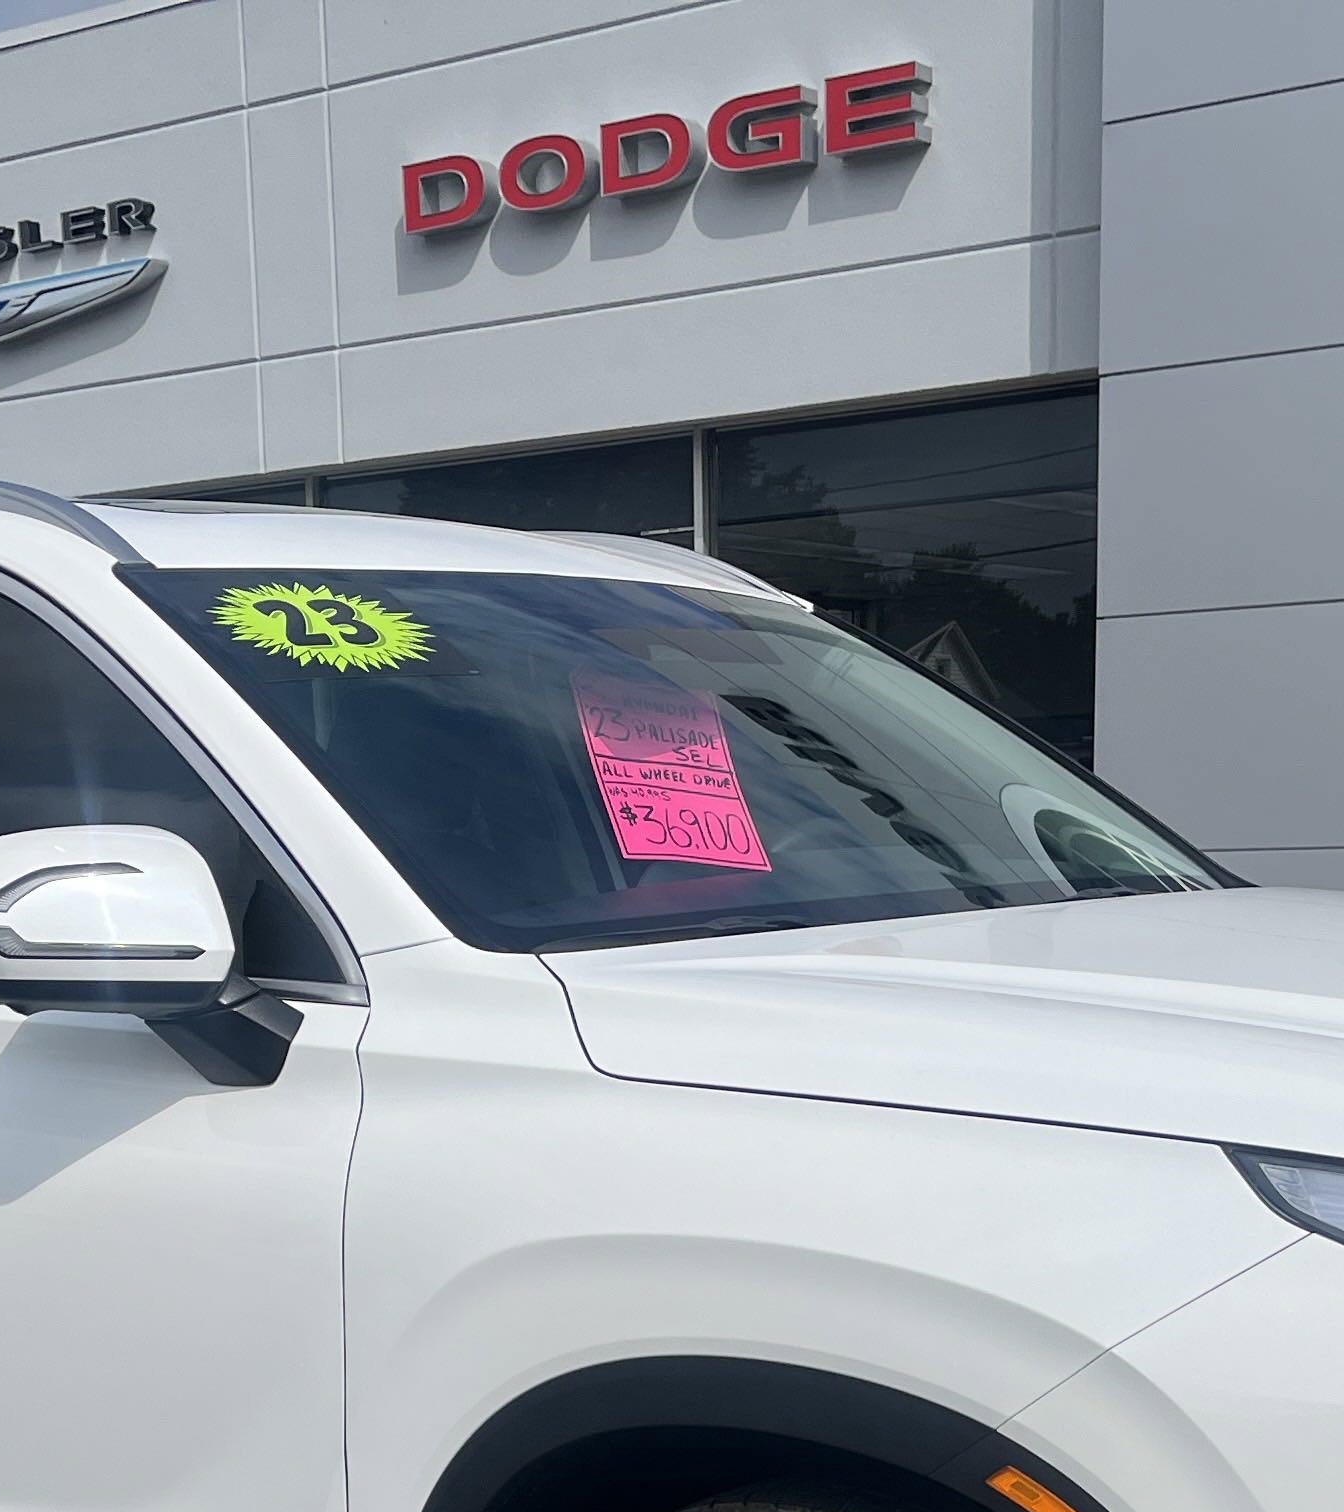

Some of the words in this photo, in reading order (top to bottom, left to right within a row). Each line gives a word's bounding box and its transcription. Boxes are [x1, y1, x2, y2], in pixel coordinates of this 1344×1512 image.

[402, 60, 933, 240] DODGE
[252, 599, 385, 649] 23
[633, 718, 720, 751] PALISADE
[672, 746, 722, 769] SEL
[602, 760, 634, 778] ALL
[640, 767, 687, 784] WHEEL
[693, 773, 732, 790] DRIVE
